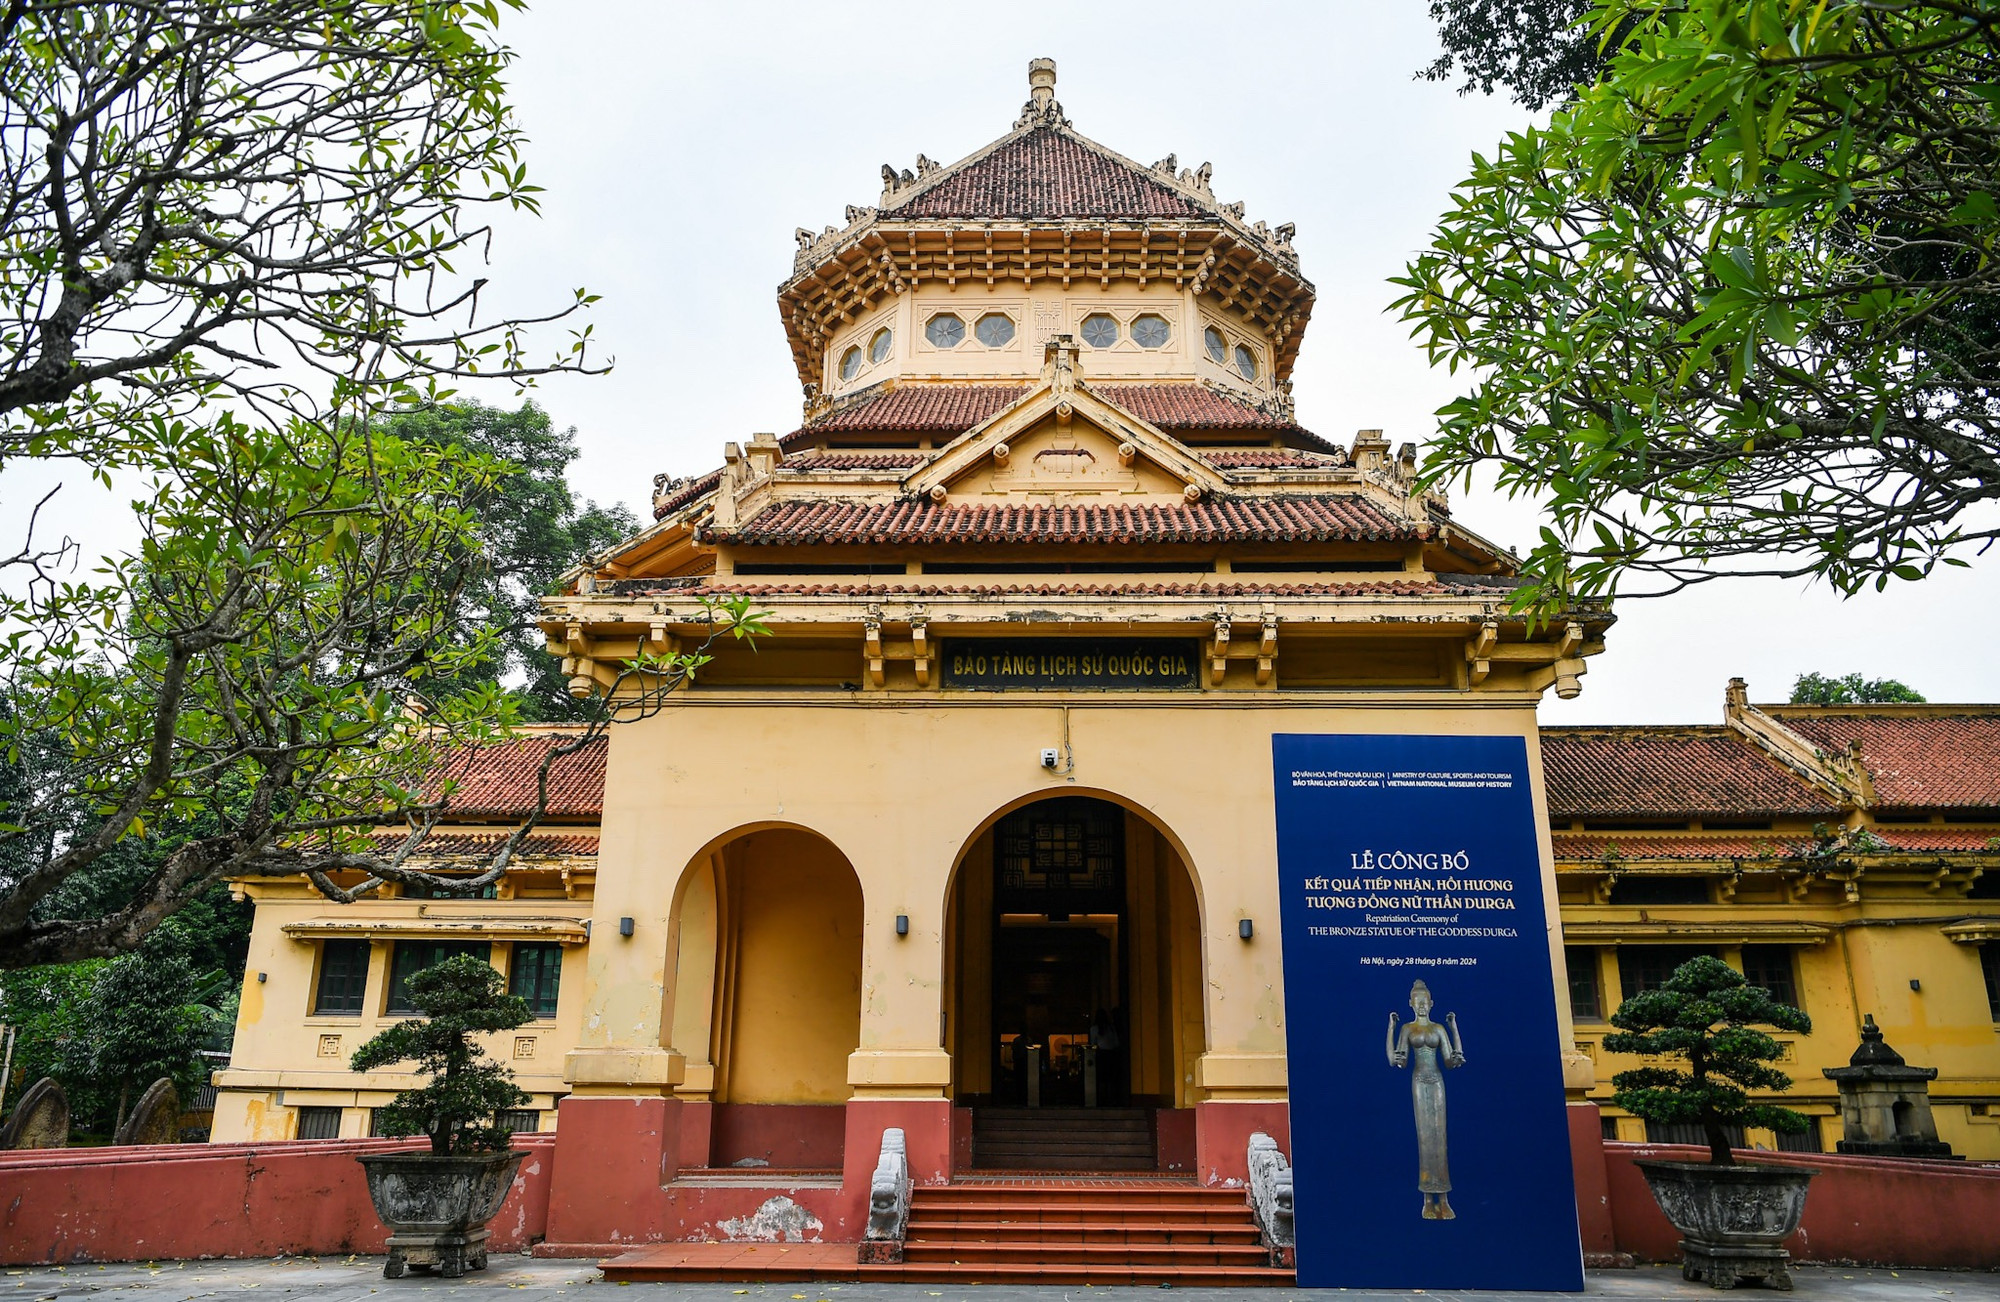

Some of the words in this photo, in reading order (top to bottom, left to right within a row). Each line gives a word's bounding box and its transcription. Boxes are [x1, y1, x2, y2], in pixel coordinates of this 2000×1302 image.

[953, 649, 986, 676] BẢO
[991, 651, 1036, 676] TÀNG
[1040, 656, 1077, 681] LỊCH
[1159, 656, 1188, 676] GIA
[1351, 849, 1375, 870] LỄ
[1377, 850, 1438, 870] CÔNG
[1441, 850, 1470, 871] BỐ
[1304, 875, 1329, 890] KẾT
[1331, 876, 1361, 892] QUẢ
[1363, 876, 1392, 890] TIẾP
[1394, 877, 1435, 892] NHẬN,
[1463, 879, 1514, 891] HƯƠNG
[1305, 896, 1356, 910] TƯỢNG
[1358, 893, 1399, 909] ĐỒNG
[1402, 895, 1422, 909] NỮ
[1464, 897, 1516, 910] DURGA
[1365, 913, 1410, 925] Repatriation
[1410, 914, 1449, 925] Ceremony
[1450, 913, 1459, 923] of
[1308, 926, 1328, 936] THE
[1329, 927, 1367, 936] BRONZE
[1368, 927, 1402, 936] STATUE
[1403, 927, 1417, 936] OF
[1417, 927, 1437, 936] THE
[1438, 927, 1482, 937] GODDESS
[1483, 928, 1518, 937] DURGA
[1360, 957, 1370, 965] Hà
[1387, 957, 1404, 966] ngày
[1405, 957, 1414, 965] 28
[1415, 957, 1435, 966] tháng
[1436, 957, 1441, 965] 8
[1460, 957, 1477, 965] 2024
